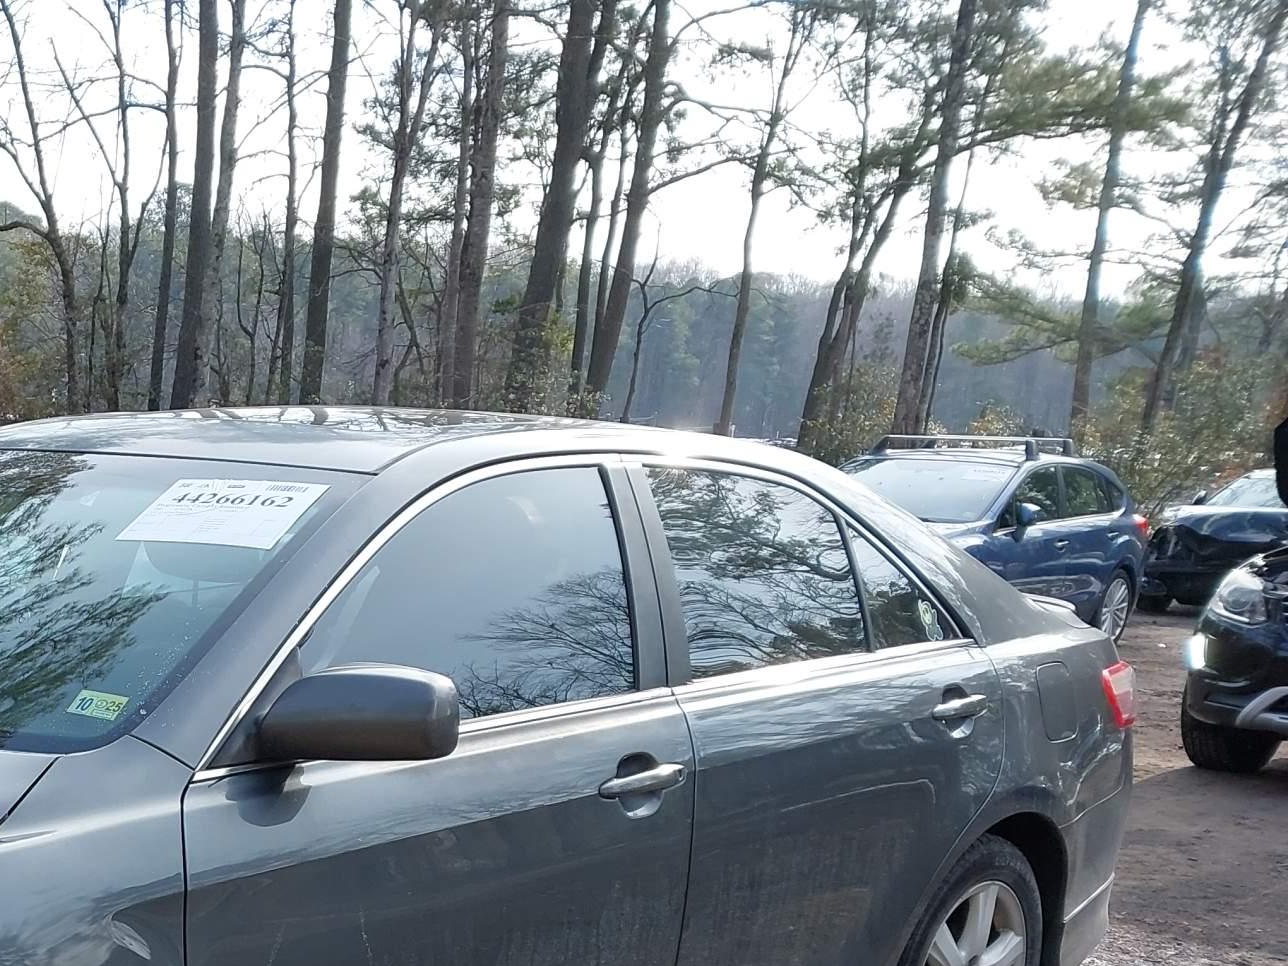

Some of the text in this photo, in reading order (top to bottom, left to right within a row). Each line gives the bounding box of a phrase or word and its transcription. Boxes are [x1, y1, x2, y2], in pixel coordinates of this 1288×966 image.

[171, 492, 294, 508] 44266162
[75, 696, 123, 713] 10 25
